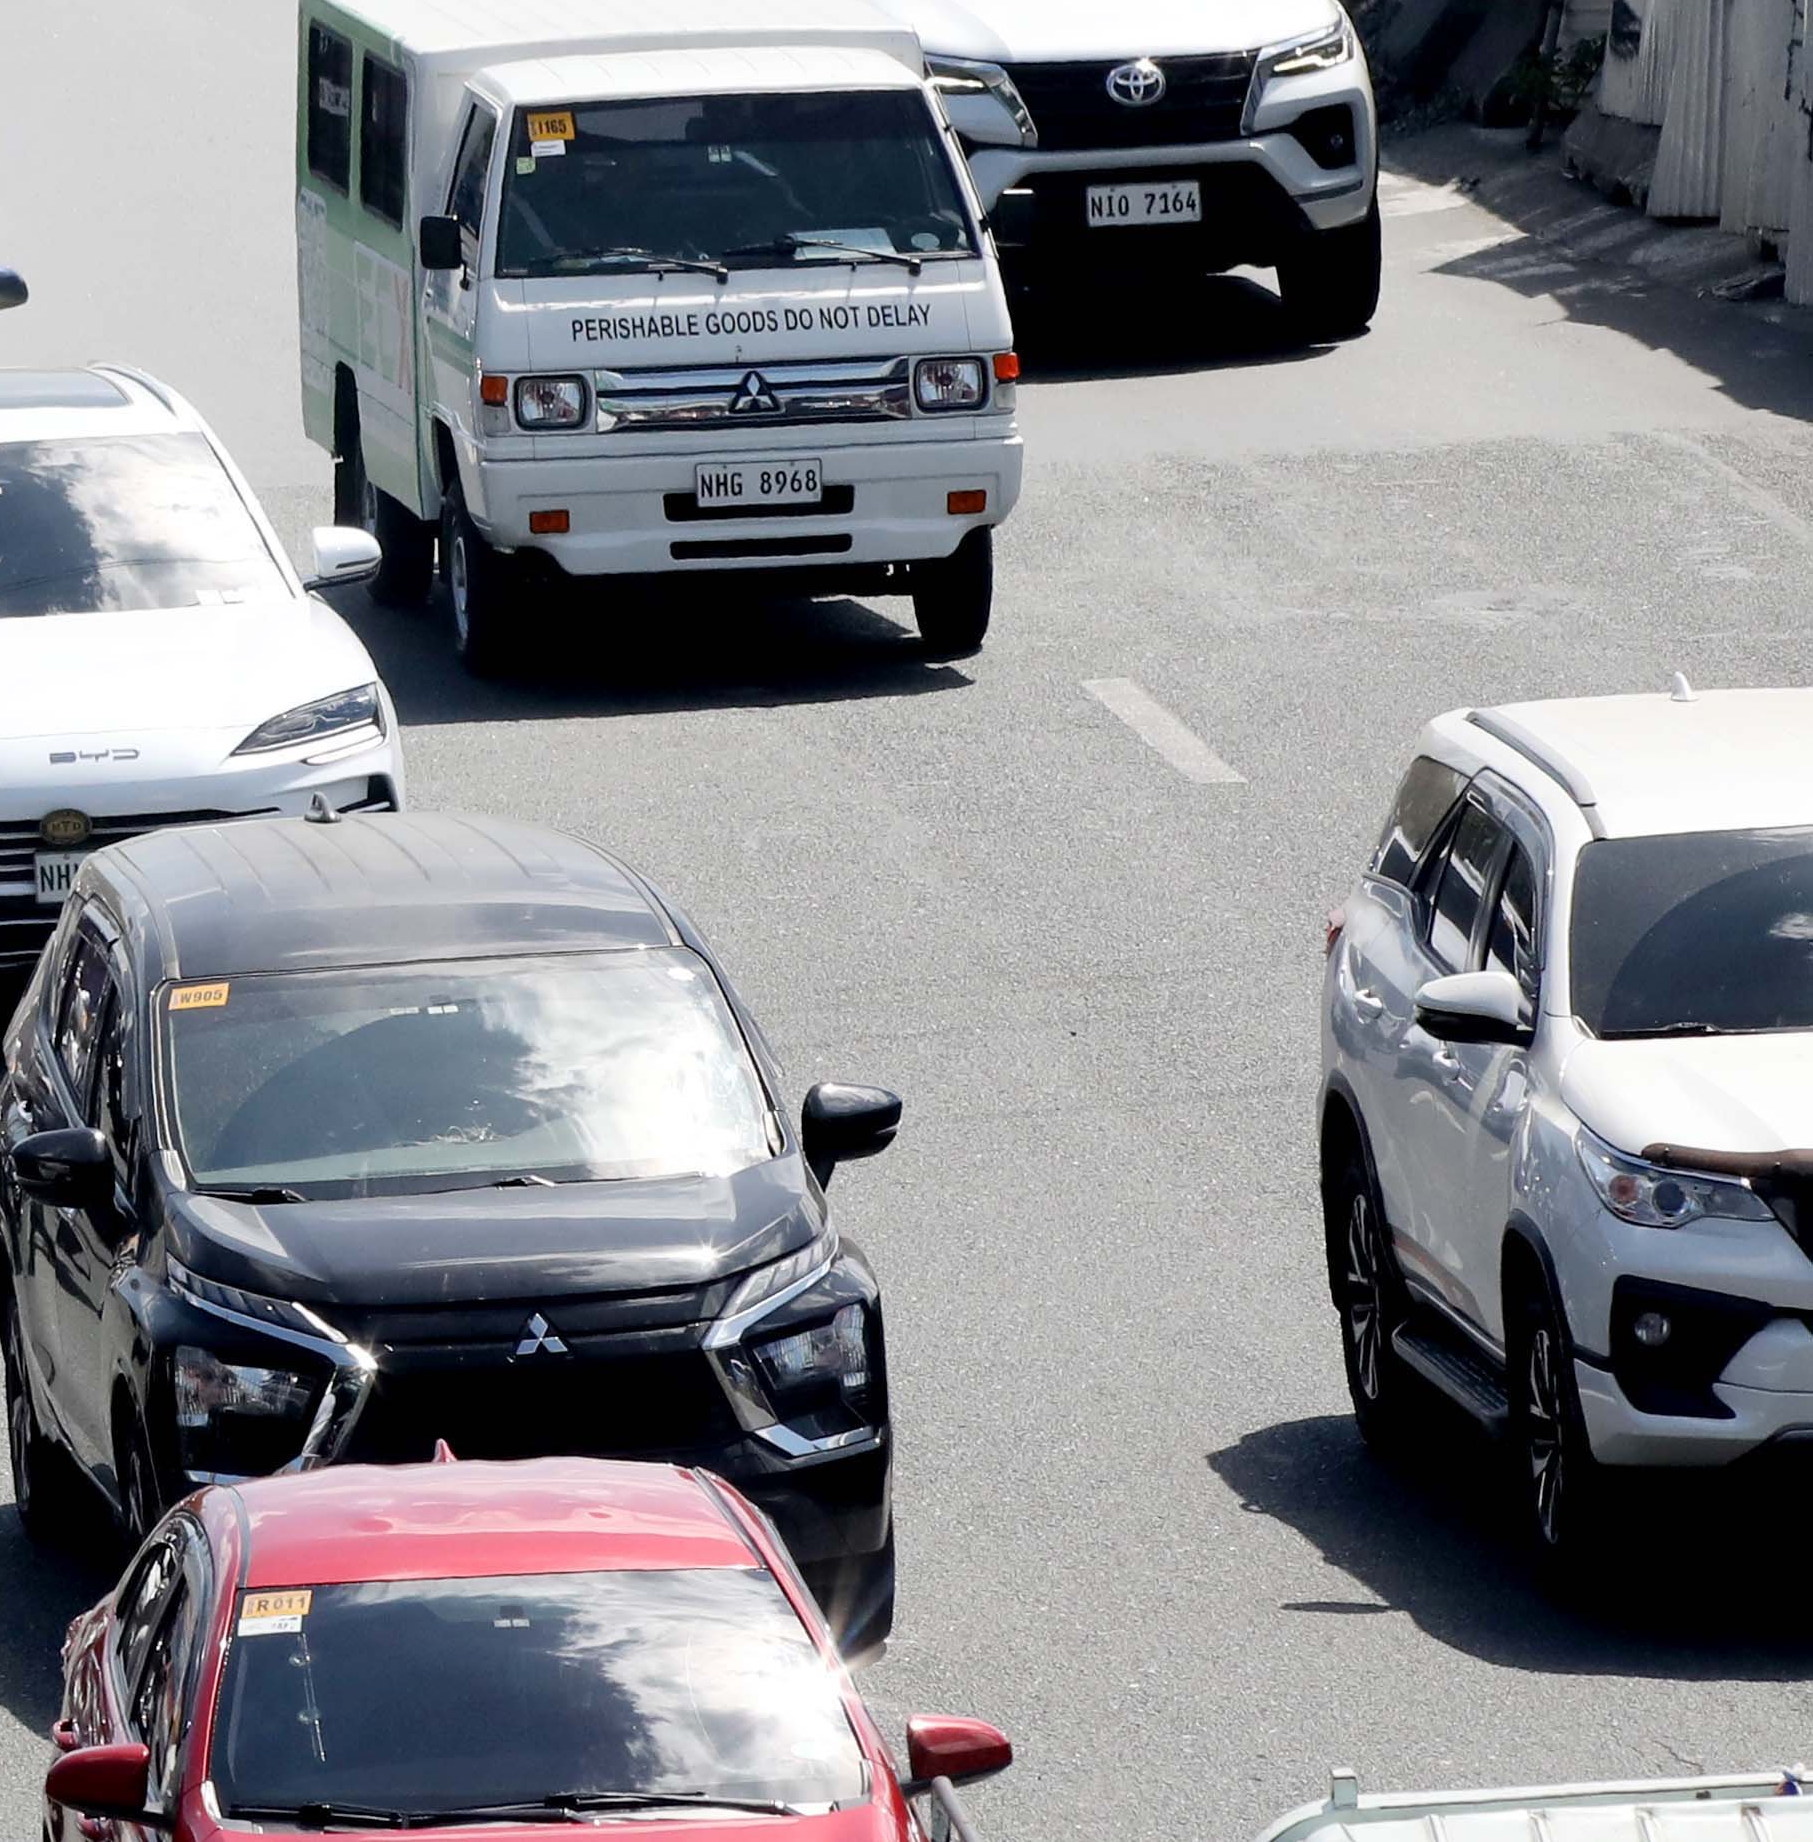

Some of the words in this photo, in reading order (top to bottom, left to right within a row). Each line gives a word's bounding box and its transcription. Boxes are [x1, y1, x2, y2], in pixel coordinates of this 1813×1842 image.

[1090, 194, 1130, 218] NIO
[1144, 190, 1196, 215] 7164
[571, 309, 700, 342] PERISHABLE
[706, 307, 779, 336] GOODS
[785, 307, 814, 332] DO
[819, 305, 861, 330] NOT
[866, 302, 932, 328] DELAY
[700, 471, 743, 498] NHG
[760, 468, 817, 495] 8968
[49, 748, 140, 765] BYD
[40, 864, 78, 892] NH
[179, 990, 224, 1005] W905
